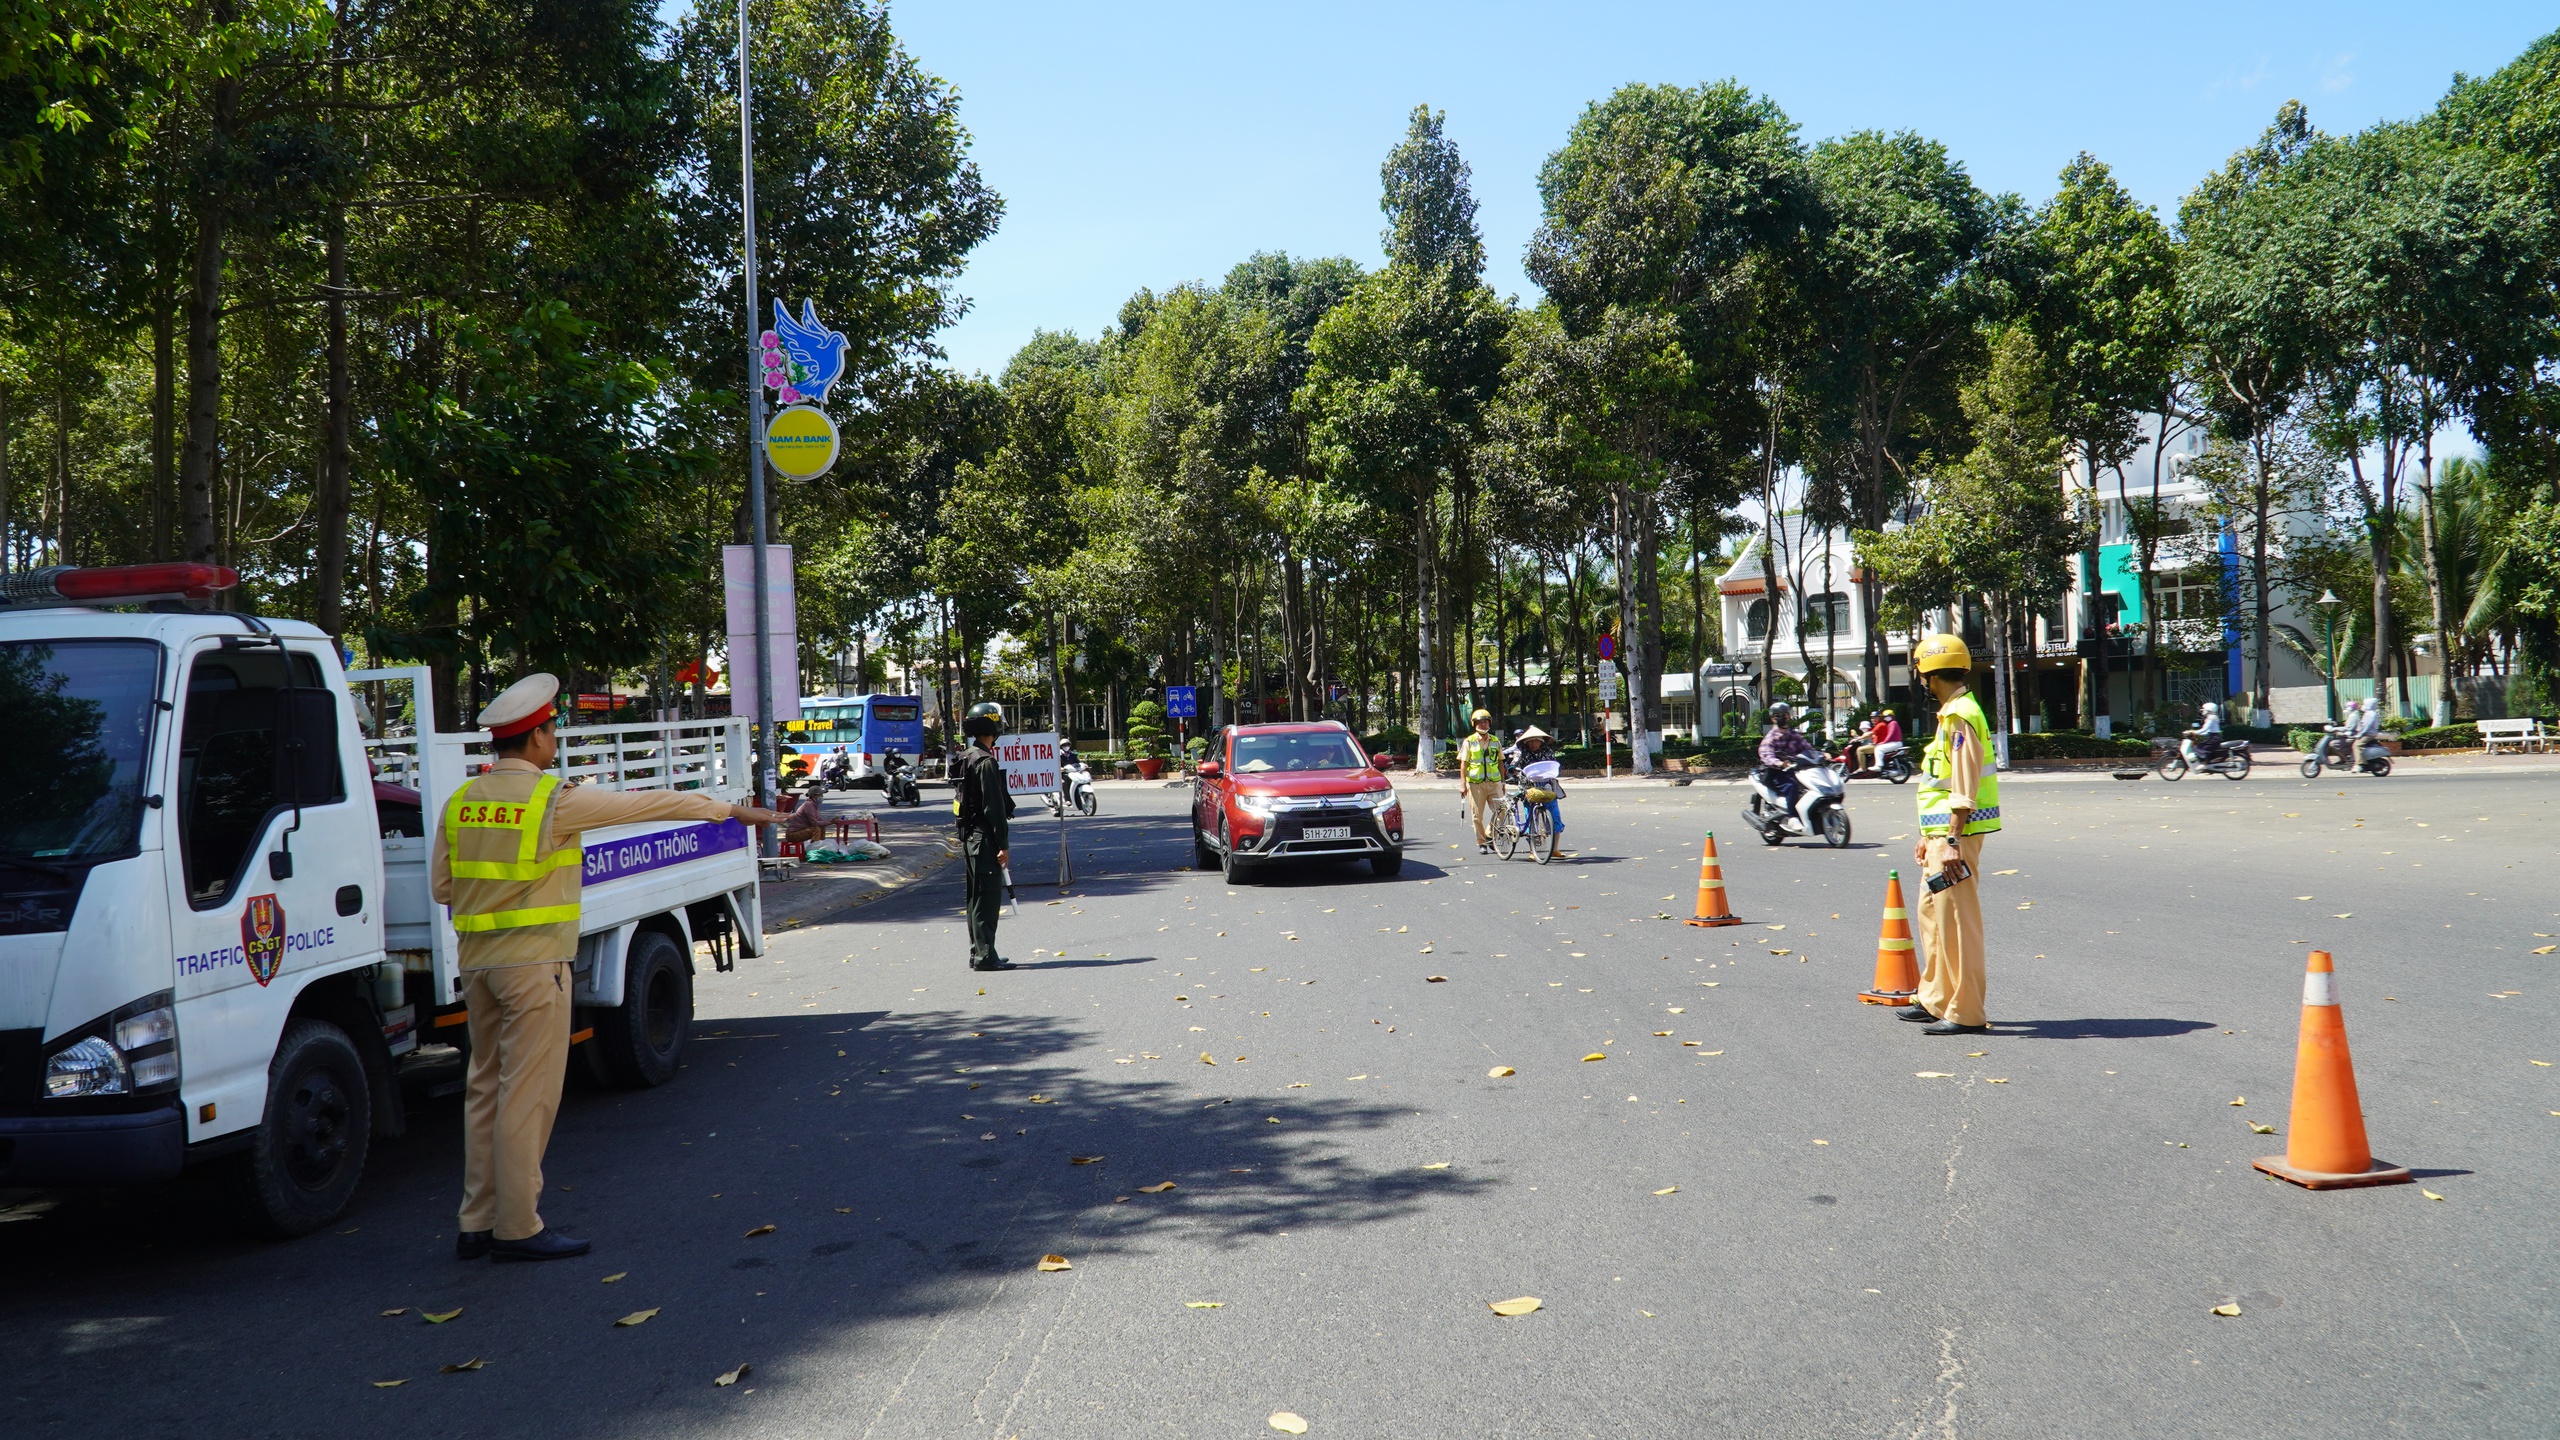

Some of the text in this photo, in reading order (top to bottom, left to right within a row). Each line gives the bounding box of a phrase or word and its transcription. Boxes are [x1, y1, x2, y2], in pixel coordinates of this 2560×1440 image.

[1921, 645, 1948, 659] CSGT
[808, 719, 833, 731] Travel
[1004, 738, 1030, 762] KIỂM
[1033, 744, 1054, 760] TRA
[1028, 773, 1039, 788] MA
[1040, 769, 1054, 787] TÚY
[459, 806, 526, 825] C.S.G.T
[1304, 828, 1348, 839] 51H-271.31
[586, 831, 698, 877] SÁT GIAO THÔNG
[176, 926, 335, 977] TRAFFIC POLICE
